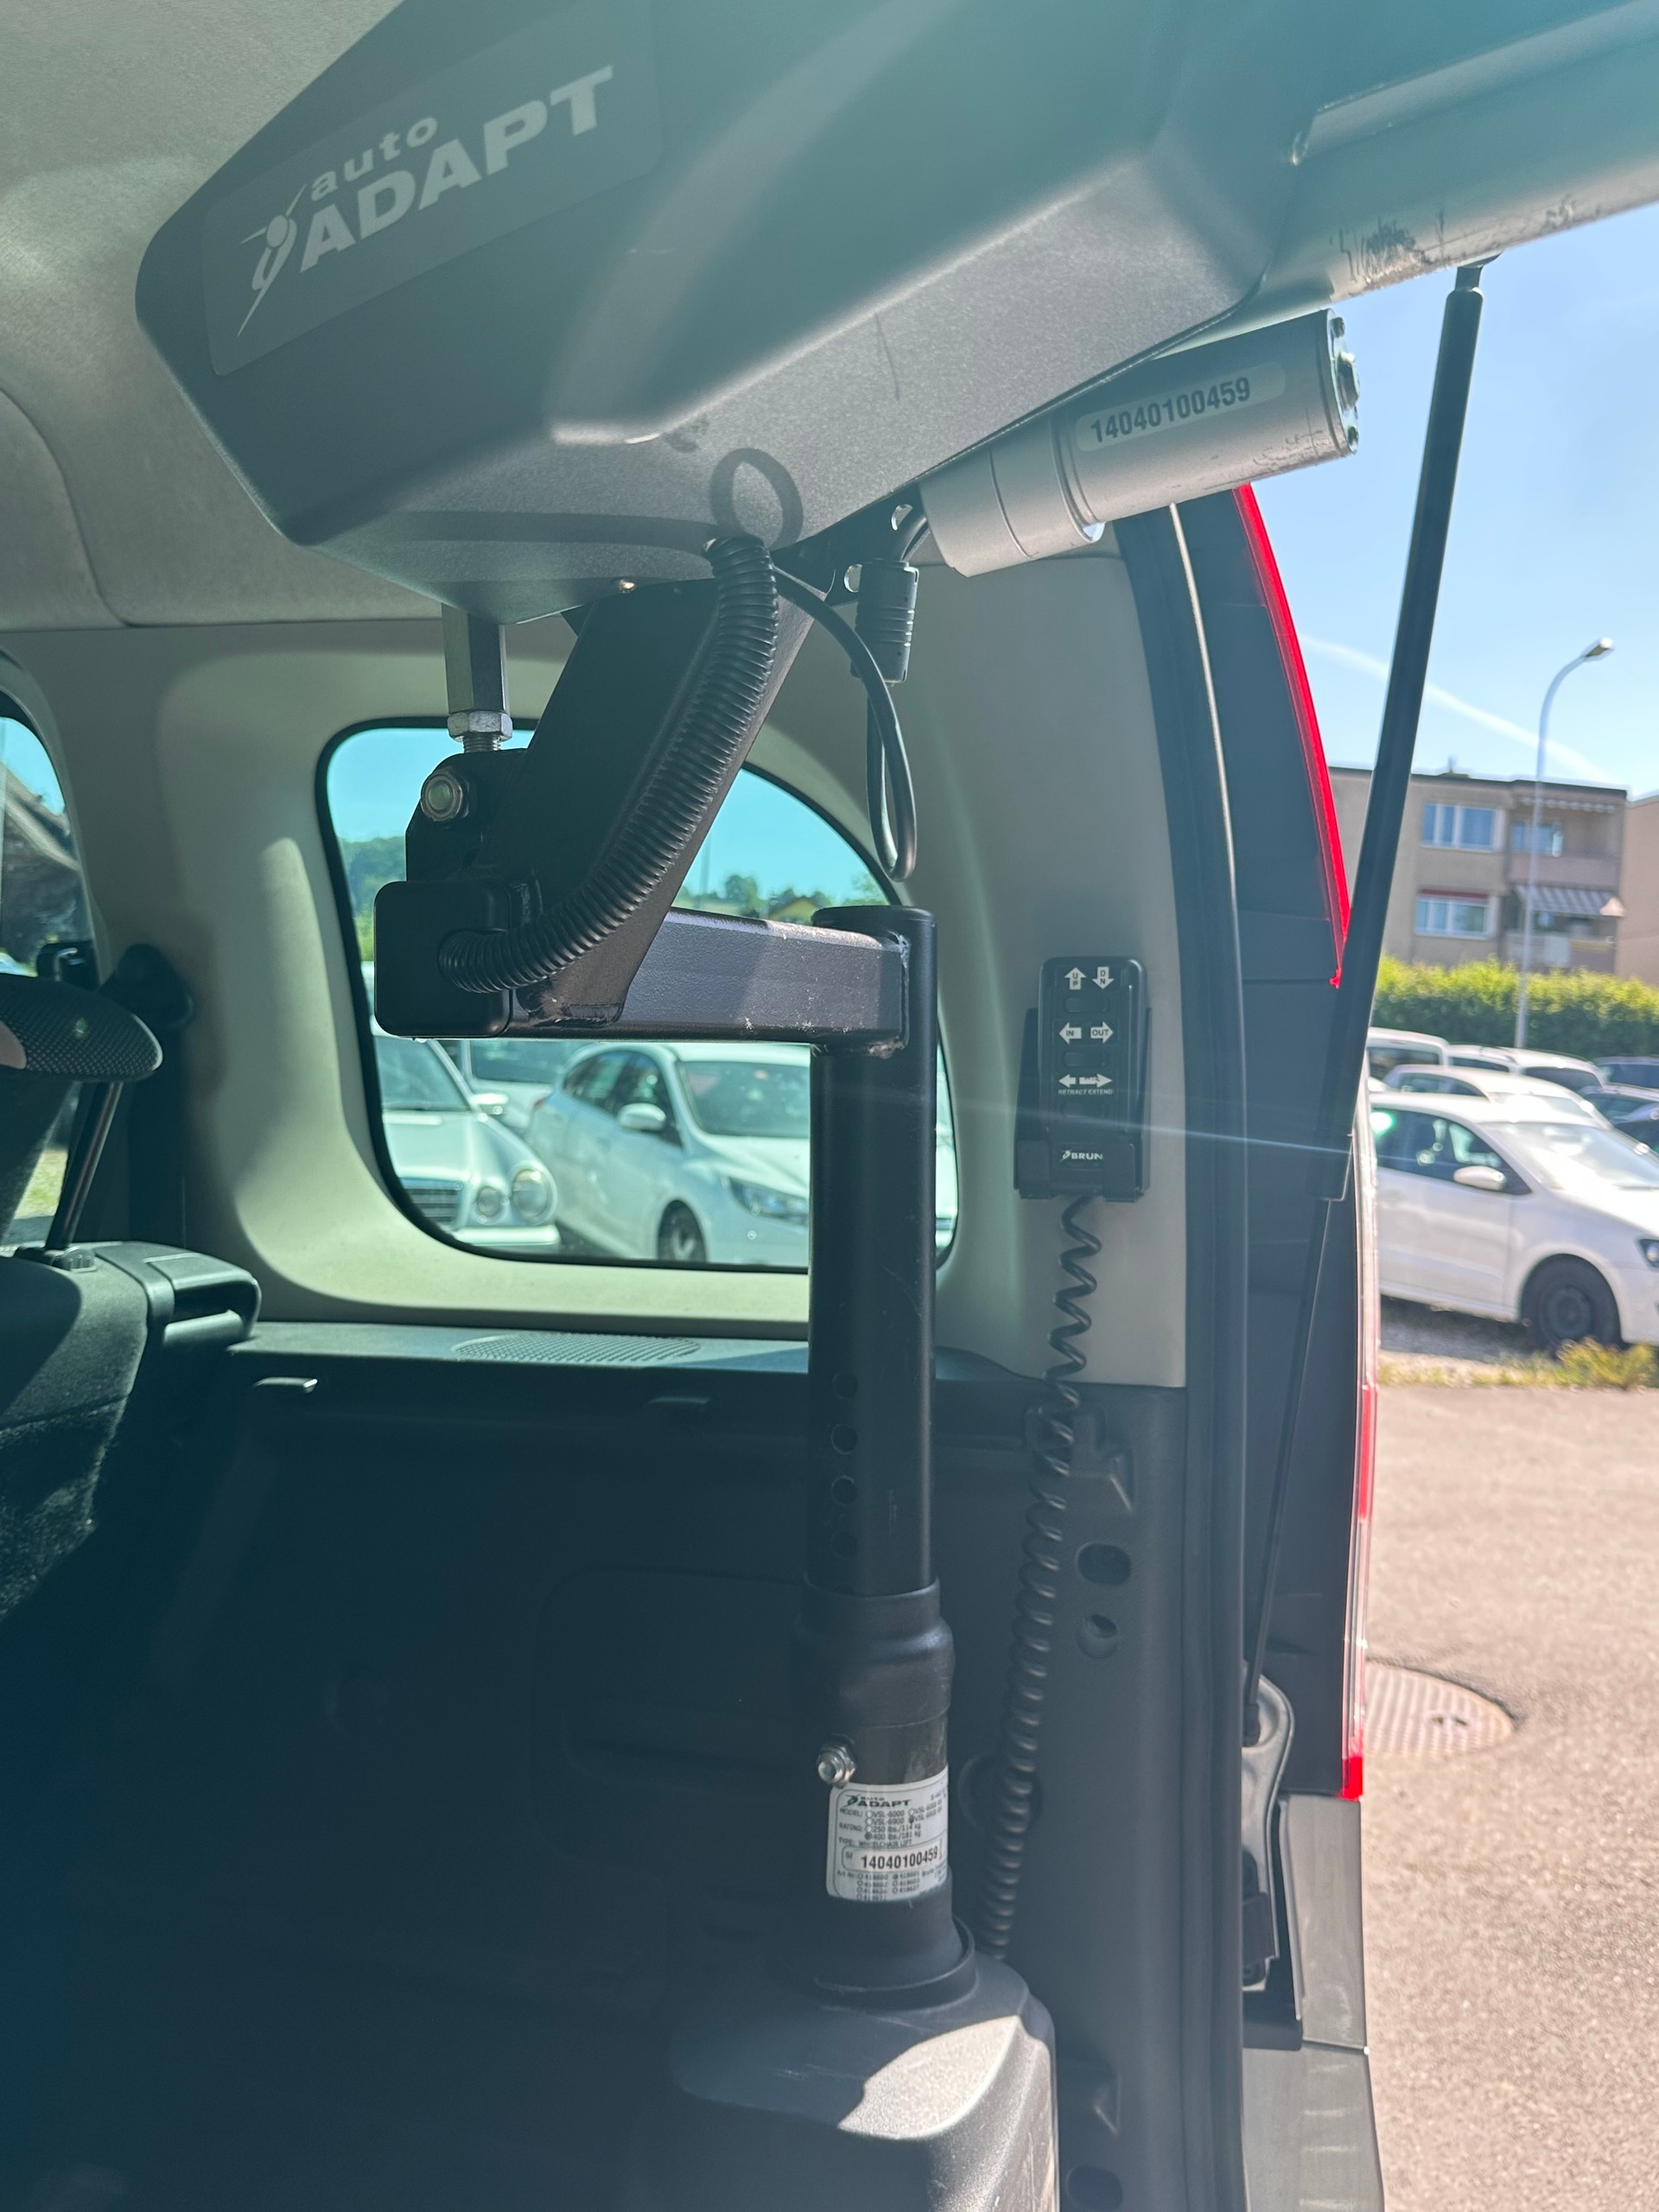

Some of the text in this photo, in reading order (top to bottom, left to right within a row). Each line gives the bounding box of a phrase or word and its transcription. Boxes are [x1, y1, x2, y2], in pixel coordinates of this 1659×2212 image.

[299, 64, 614, 274] ADAPT
[310, 116, 439, 202] auto
[1090, 377, 1250, 443] 14040100459
[840, 1808, 863, 1816] MODEL:
[857, 1799, 911, 1808] ADAPT
[861, 1846, 938, 1869] 14040100459
